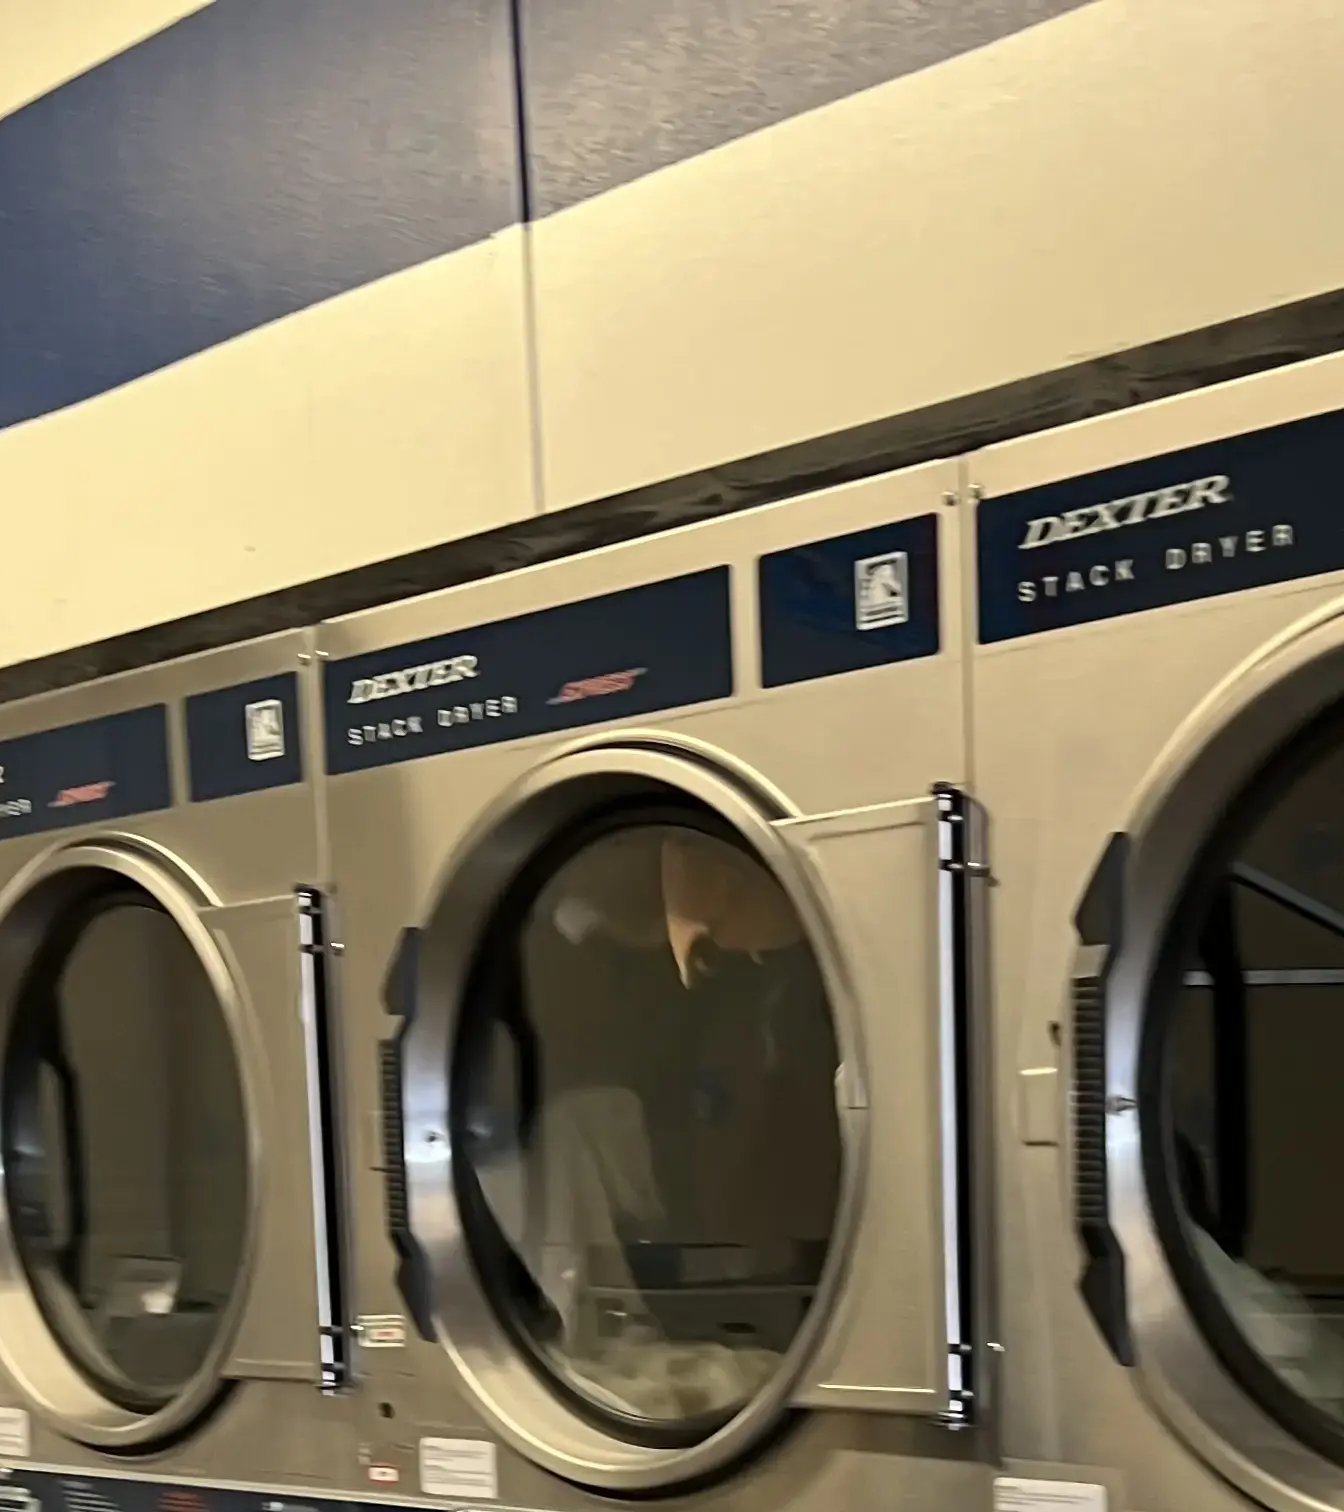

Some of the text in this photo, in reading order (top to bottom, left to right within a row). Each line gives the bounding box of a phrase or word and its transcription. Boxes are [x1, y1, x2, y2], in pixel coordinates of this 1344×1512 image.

[1018, 474, 1232, 549] DEXTER
[1017, 524, 1294, 602] STACK DRYER
